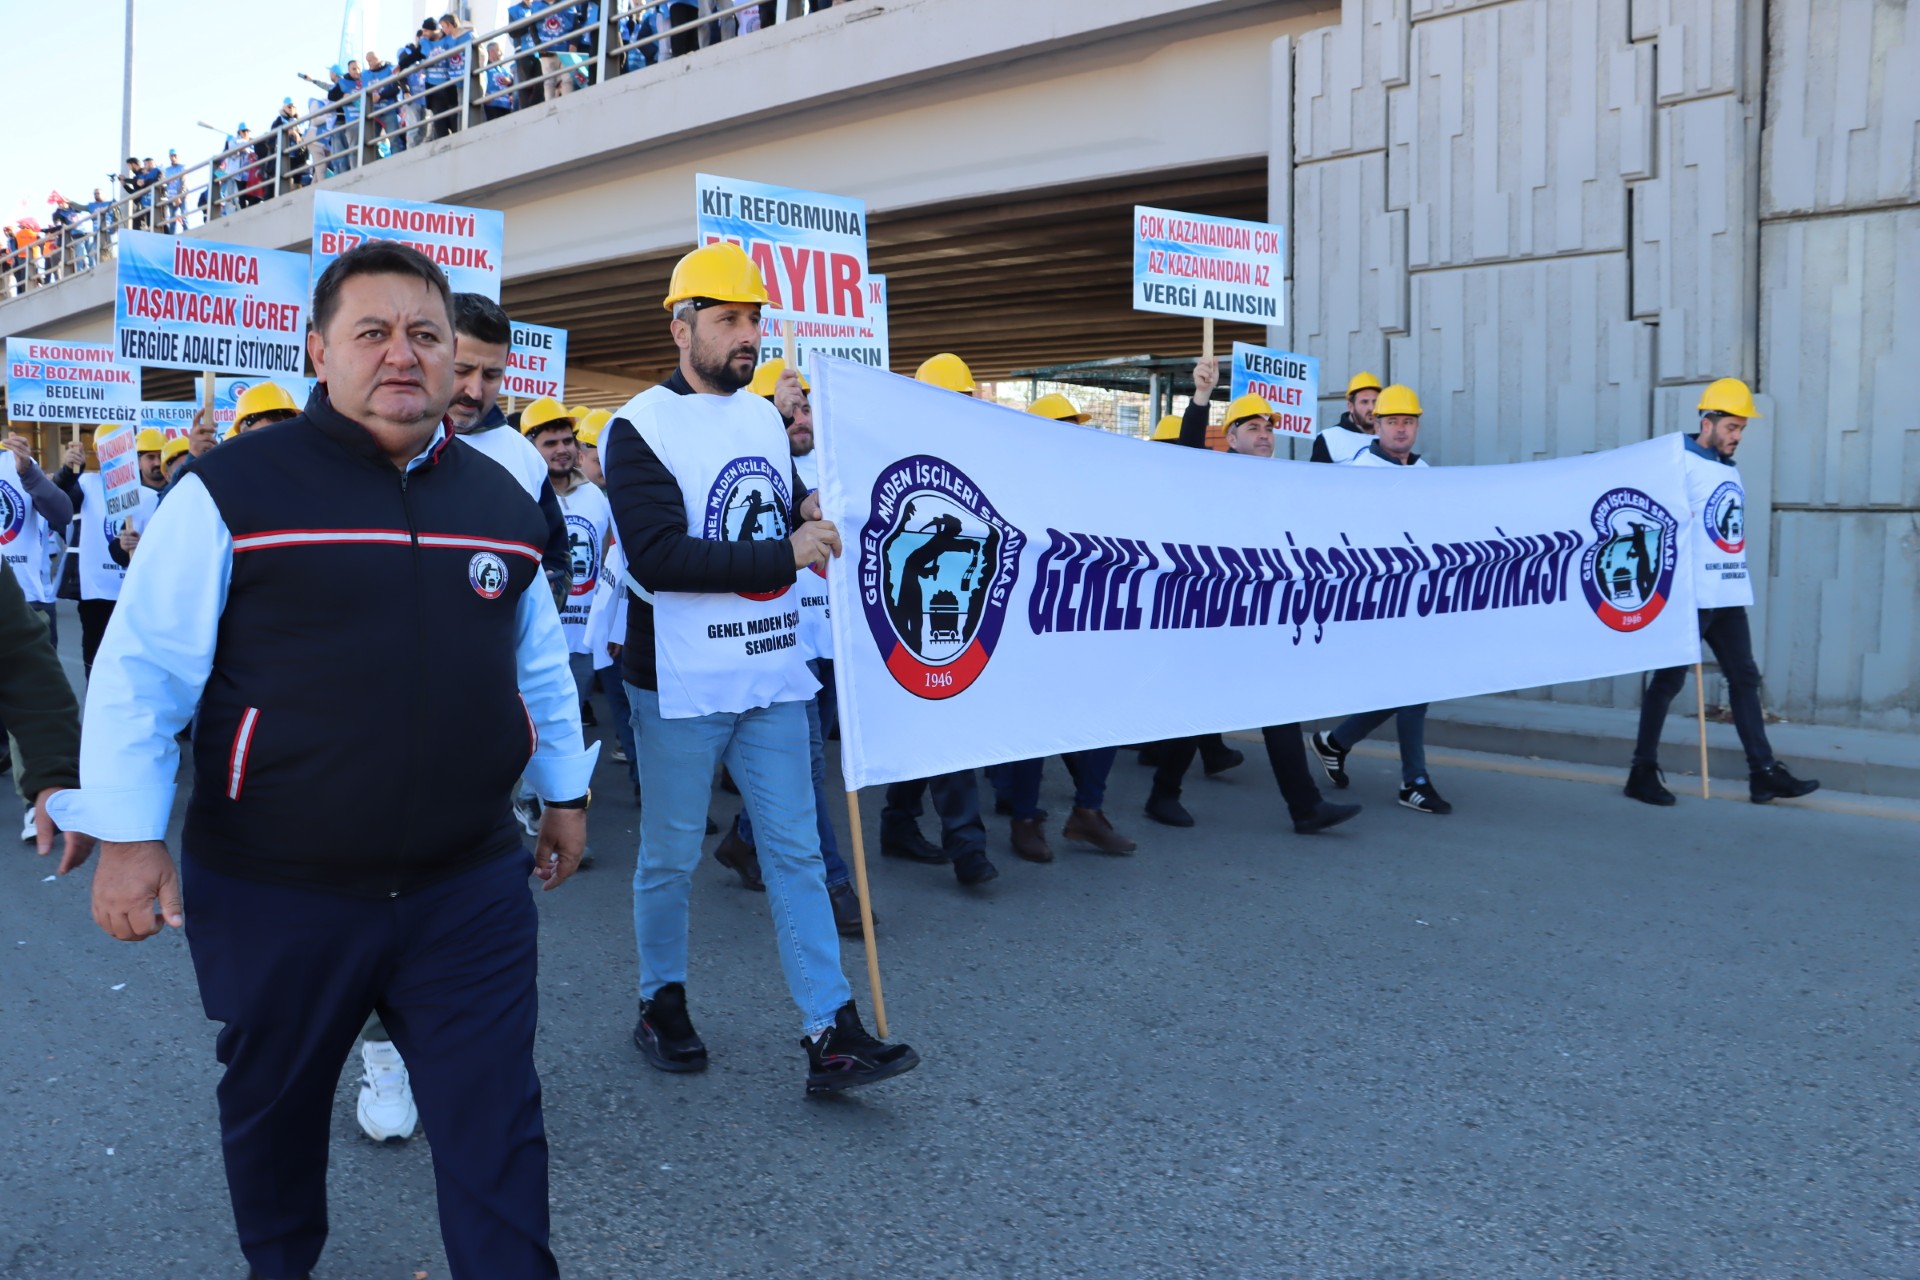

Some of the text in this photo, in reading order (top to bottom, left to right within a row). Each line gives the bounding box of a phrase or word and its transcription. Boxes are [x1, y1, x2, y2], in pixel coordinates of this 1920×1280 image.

[345, 204, 475, 238] EKONOMİYİ
[702, 186, 861, 236] KİT REFORMUNA
[321, 230, 360, 254] BİZ
[1140, 215, 1278, 254] ÇOK KAZANANDAN ÇOK
[174, 241, 258, 285] İNSANCA
[706, 236, 864, 319] AYIR
[1149, 251, 1269, 287] AZ KAZANANDAN AZ
[125, 286, 299, 332] YAŞAYACAK ÜCRET
[1143, 282, 1276, 317] VERGİ ALINSIN
[121, 326, 300, 372] VERGİDE ADALET İSTİYORUZ
[513, 327, 552, 350] GİDE
[29, 345, 114, 363] EKONOMİY
[507, 351, 547, 372] ALET
[1245, 352, 1307, 381] VERGİDE
[13, 362, 40, 379] BİZ
[46, 384, 104, 401] BEDELİNİ
[503, 374, 558, 397] YORUZ
[1248, 380, 1302, 406] ADALET
[13, 401, 137, 421] BİZ ÖDEMEYECEĞİZ
[710, 467, 738, 509] MADEN
[865, 461, 1018, 608] GENEL MADEN İŞÇİLERİ SENDİKASI
[1595, 504, 1611, 535] MADEN
[1608, 491, 1649, 510] İŞÇİLERİ
[1650, 505, 1675, 571] SENDİKASI
[1028, 526, 1583, 646] GENEL MADEN İŞÇİLERİ SENDİKASI
[801, 596, 825, 607] GENEL
[708, 622, 745, 639] GENEL
[747, 615, 782, 635] MADEN
[745, 632, 796, 656] SENDİKASI
[925, 671, 952, 688] 1946
